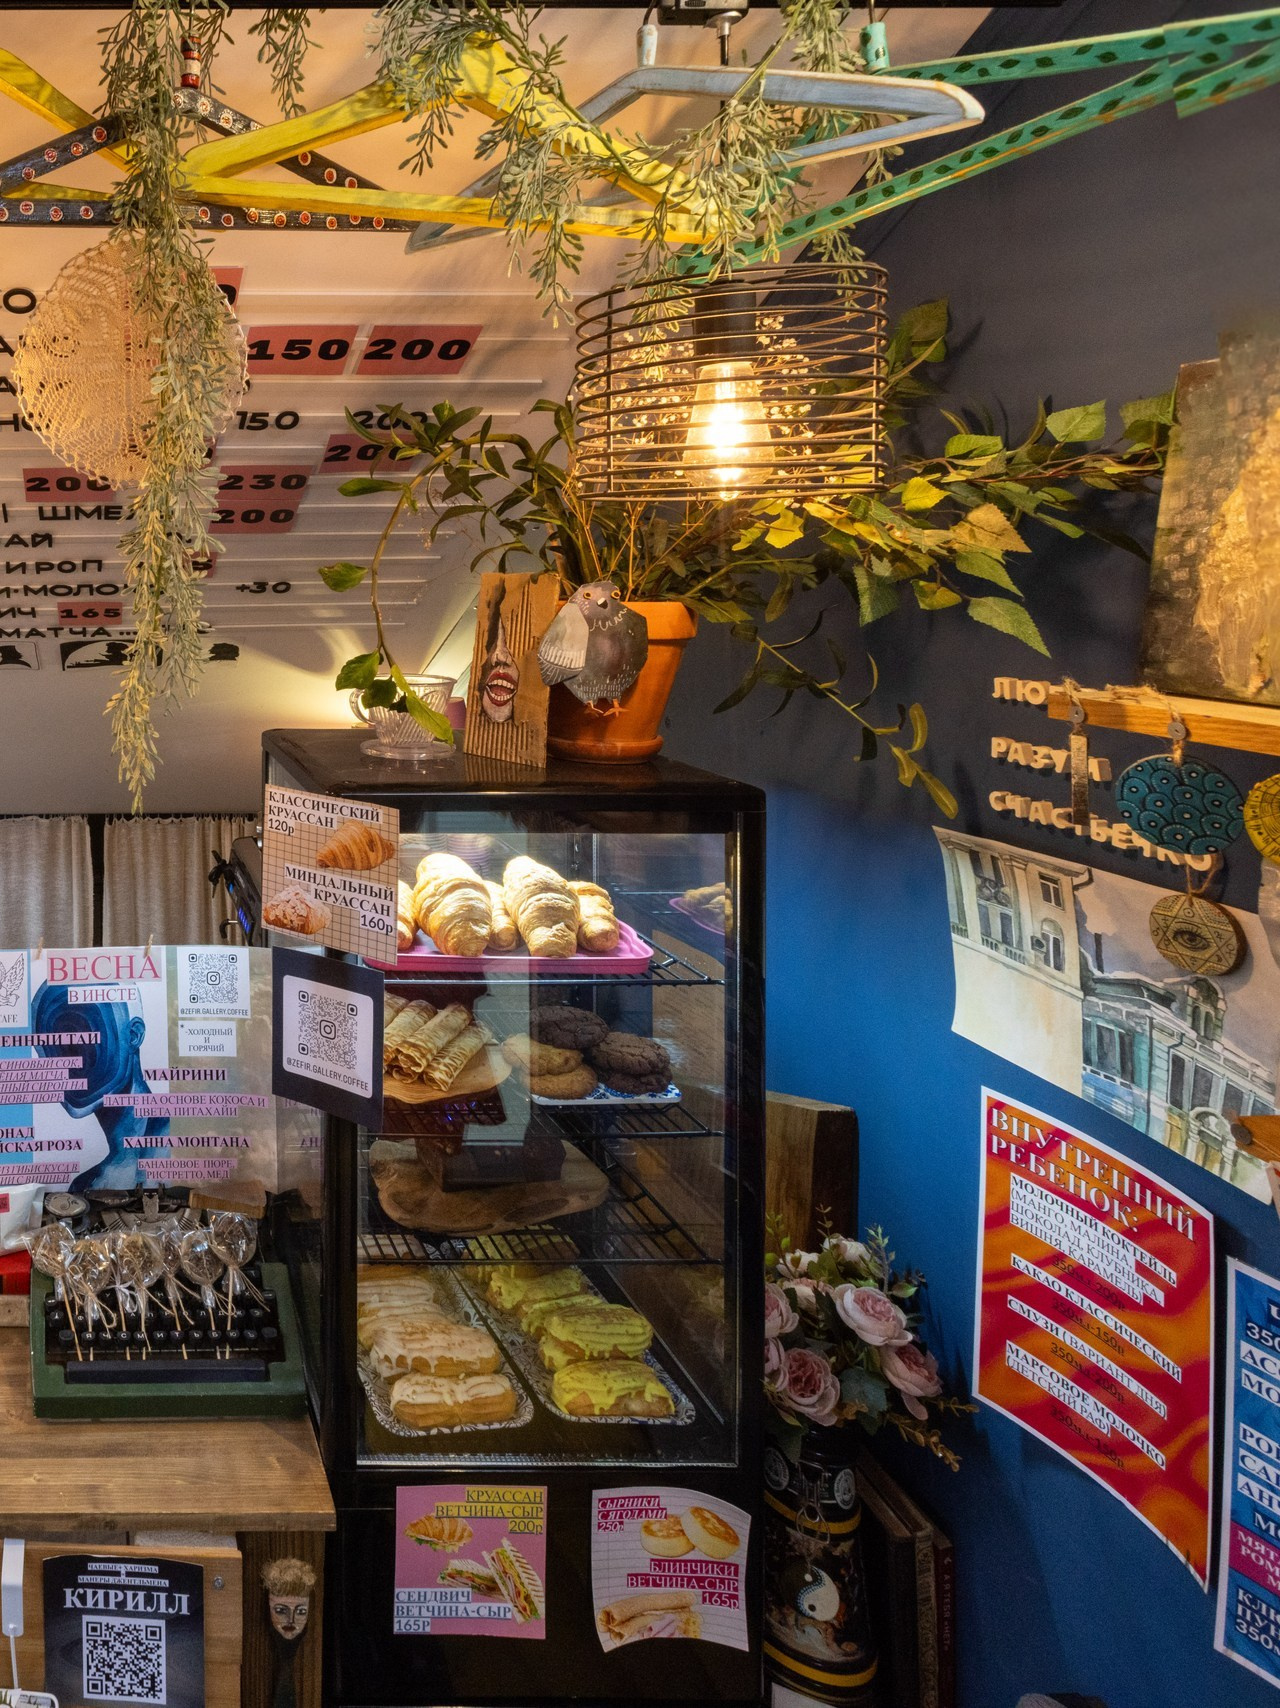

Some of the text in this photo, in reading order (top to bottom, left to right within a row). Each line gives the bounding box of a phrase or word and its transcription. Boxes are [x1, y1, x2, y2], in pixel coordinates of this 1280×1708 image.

[247, 338, 472, 361] 150 200
[235, 410, 429, 431] 150 200
[322, 444, 416, 463] 200
[218, 473, 308, 491] 230
[210, 508, 295, 524] 200
[235, 581, 293, 594] +30
[59, 607, 122, 619] 165
[269, 791, 381, 823] КЛАССИЧЕСКИЙ
[268, 804, 335, 829] КРУАССАН
[268, 818, 295, 836] 120р
[285, 866, 394, 902] МИНДАЛЬНЫЙ
[314, 888, 391, 918] КРУАССАН
[360, 914, 394, 936] 160р
[48, 953, 161, 983] ВЕСНА
[68, 987, 138, 1003] В ИНСТЕ
[180, 1007, 249, 1017] @ZEFIR.GALLERY.COFFEE
[204, 1036, 211, 1044] И
[188, 1044, 225, 1052] ГОРЯЧИЙ
[144, 1066, 227, 1081] МАЙРИНИ
[286, 1056, 369, 1092] @ZEFIR.GALLERY.COFFEE
[31, 1080, 69, 1092] СИРОП
[70, 1080, 86, 1090] НА
[27, 1092, 63, 1104] ПЮРЕ
[104, 1094, 265, 1108] ЛАТТЕ НА ОСНОВЕ КОКОСА И
[134, 1105, 238, 1119] ЦВЕТА ПИТАХАЙИ
[47, 1139, 83, 1152] РОЗА
[123, 1136, 250, 1149] ХАННА МОНТАНА
[10, 1163, 70, 1176] ГИБИСКУСА
[71, 1163, 79, 1172] В
[138, 1159, 235, 1170] БАНАНОВОЕ ПЮРЕ,
[16, 1175, 24, 1185] С
[146, 1170, 229, 1181] РИСТРЕТТО, МЕД
[990, 1107, 1197, 1243] ВНУТРЕННИЙ
[1011, 1175, 1178, 1287] МОЛОЧНЫЙ КОКТЕЙЛЬ
[1068, 1246, 1144, 1304] КАРАМЕЛЬ)
[1011, 1255, 1062, 1294] КАКАО
[1064, 1288, 1182, 1381] КЛАССИЧЕСКИЙ
[1007, 1298, 1060, 1338] СМУЗИ
[1134, 1384, 1168, 1419] ДНЯ)
[1005, 1355, 1112, 1437] (ДЕТСКИЙ РАФ)
[1006, 1343, 1166, 1469] МАРСОВОЕ МОЛОЧКО
[466, 1489, 544, 1503] КРУАССАН
[597, 1497, 660, 1510] СЫРНИКИ
[435, 1504, 544, 1518] ВЕТЧИНА-СЫР
[597, 1508, 667, 1521] С ЯГОДАМИ
[508, 1520, 543, 1534] 200р
[597, 1521, 624, 1532] 250р
[123, 1564, 159, 1573] ХАРИЗМА
[650, 1560, 735, 1577] БЛИНЧИКИ
[78, 1576, 169, 1588] МАНЕРЫ ДЖЕНТЕЛЬМЕНА
[627, 1574, 738, 1591] ВЕТЧИНА-СЫР
[62, 1587, 191, 1616] КИРИЛЛ
[395, 1589, 472, 1604] СЕНДВИЧ
[701, 1591, 739, 1610] 165р
[395, 1604, 512, 1619] ВЕТЧИНА-СЫР
